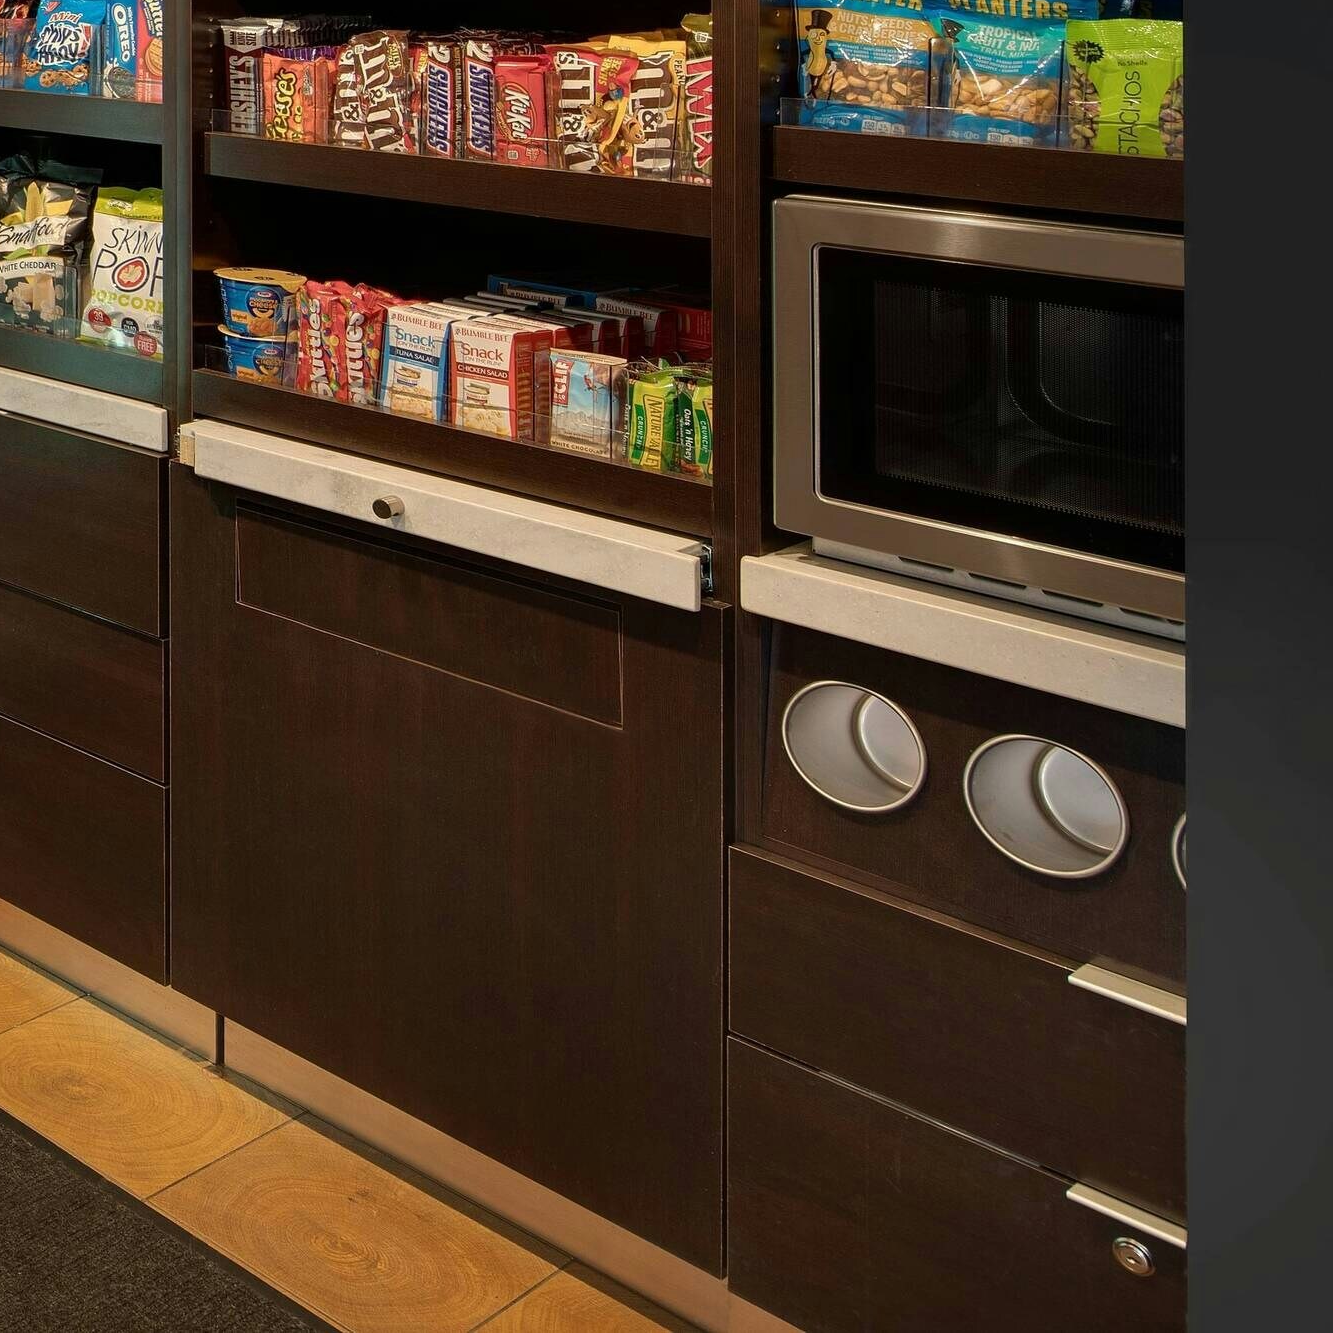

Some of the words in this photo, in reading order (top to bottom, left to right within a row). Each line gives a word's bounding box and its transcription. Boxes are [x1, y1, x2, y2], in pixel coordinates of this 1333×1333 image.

[113, 4, 131, 62] OREO
[246, 32, 256, 46] SIZE
[978, 24, 1039, 43] TROPICAL
[980, 46, 1008, 56] TRAIL
[1006, 42, 1016, 51] &
[674, 60, 686, 85] PEANU
[229, 55, 257, 135] ERSHEY'S
[428, 61, 450, 154] SNICKERS
[469, 64, 494, 154] SNICKERS
[1118, 70, 1141, 154] STACHIOS
[105, 225, 162, 255] SKINN
[19, 261, 56, 270] CHEDDAR
[606, 303, 637, 315] BUMBLE
[397, 313, 428, 327] BUMBLE
[429, 321, 443, 331] BEE
[396, 327, 436, 348] Snack
[461, 327, 492, 339] BUMBLE
[494, 334, 509, 342] BEE
[138, 342, 156, 353] FREE
[396, 350, 414, 358] TUNA
[414, 353, 434, 363] SALAD
[461, 343, 504, 362] Snack
[457, 364, 486, 375] CHICKEN
[486, 369, 508, 379] SALAD
[554, 360, 570, 394] CLIF
[647, 397, 663, 437] NATURE
[684, 408, 692, 426] Oats
[552, 440, 571, 448] WHITE
[685, 436, 693, 461] Honey
